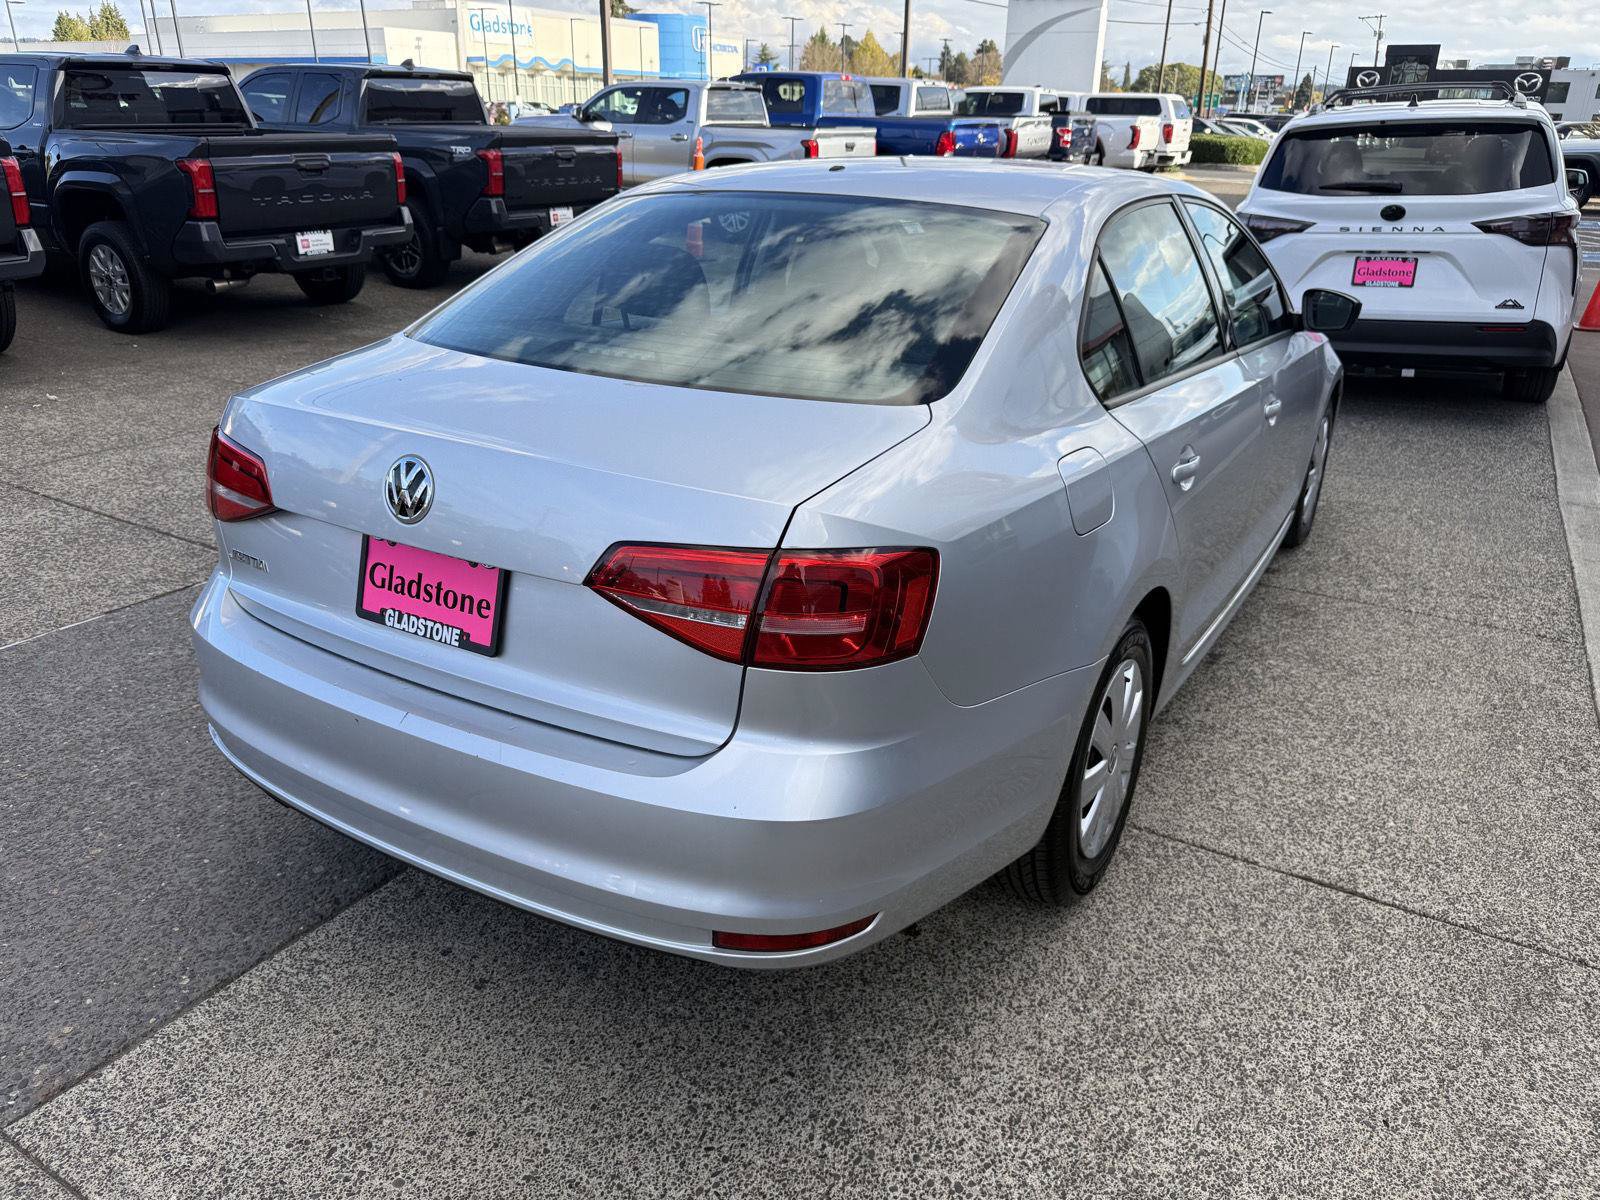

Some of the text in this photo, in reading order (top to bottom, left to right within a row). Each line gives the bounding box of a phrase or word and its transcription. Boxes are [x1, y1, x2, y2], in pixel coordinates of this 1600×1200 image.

[469, 13, 533, 37] Gadstone
[450, 146, 472, 154] TRD
[252, 190, 375, 207] TACOMA
[1357, 266, 1413, 278] Gladstone
[368, 561, 492, 620] Gladstone
[384, 608, 462, 648] GLADSTONE
